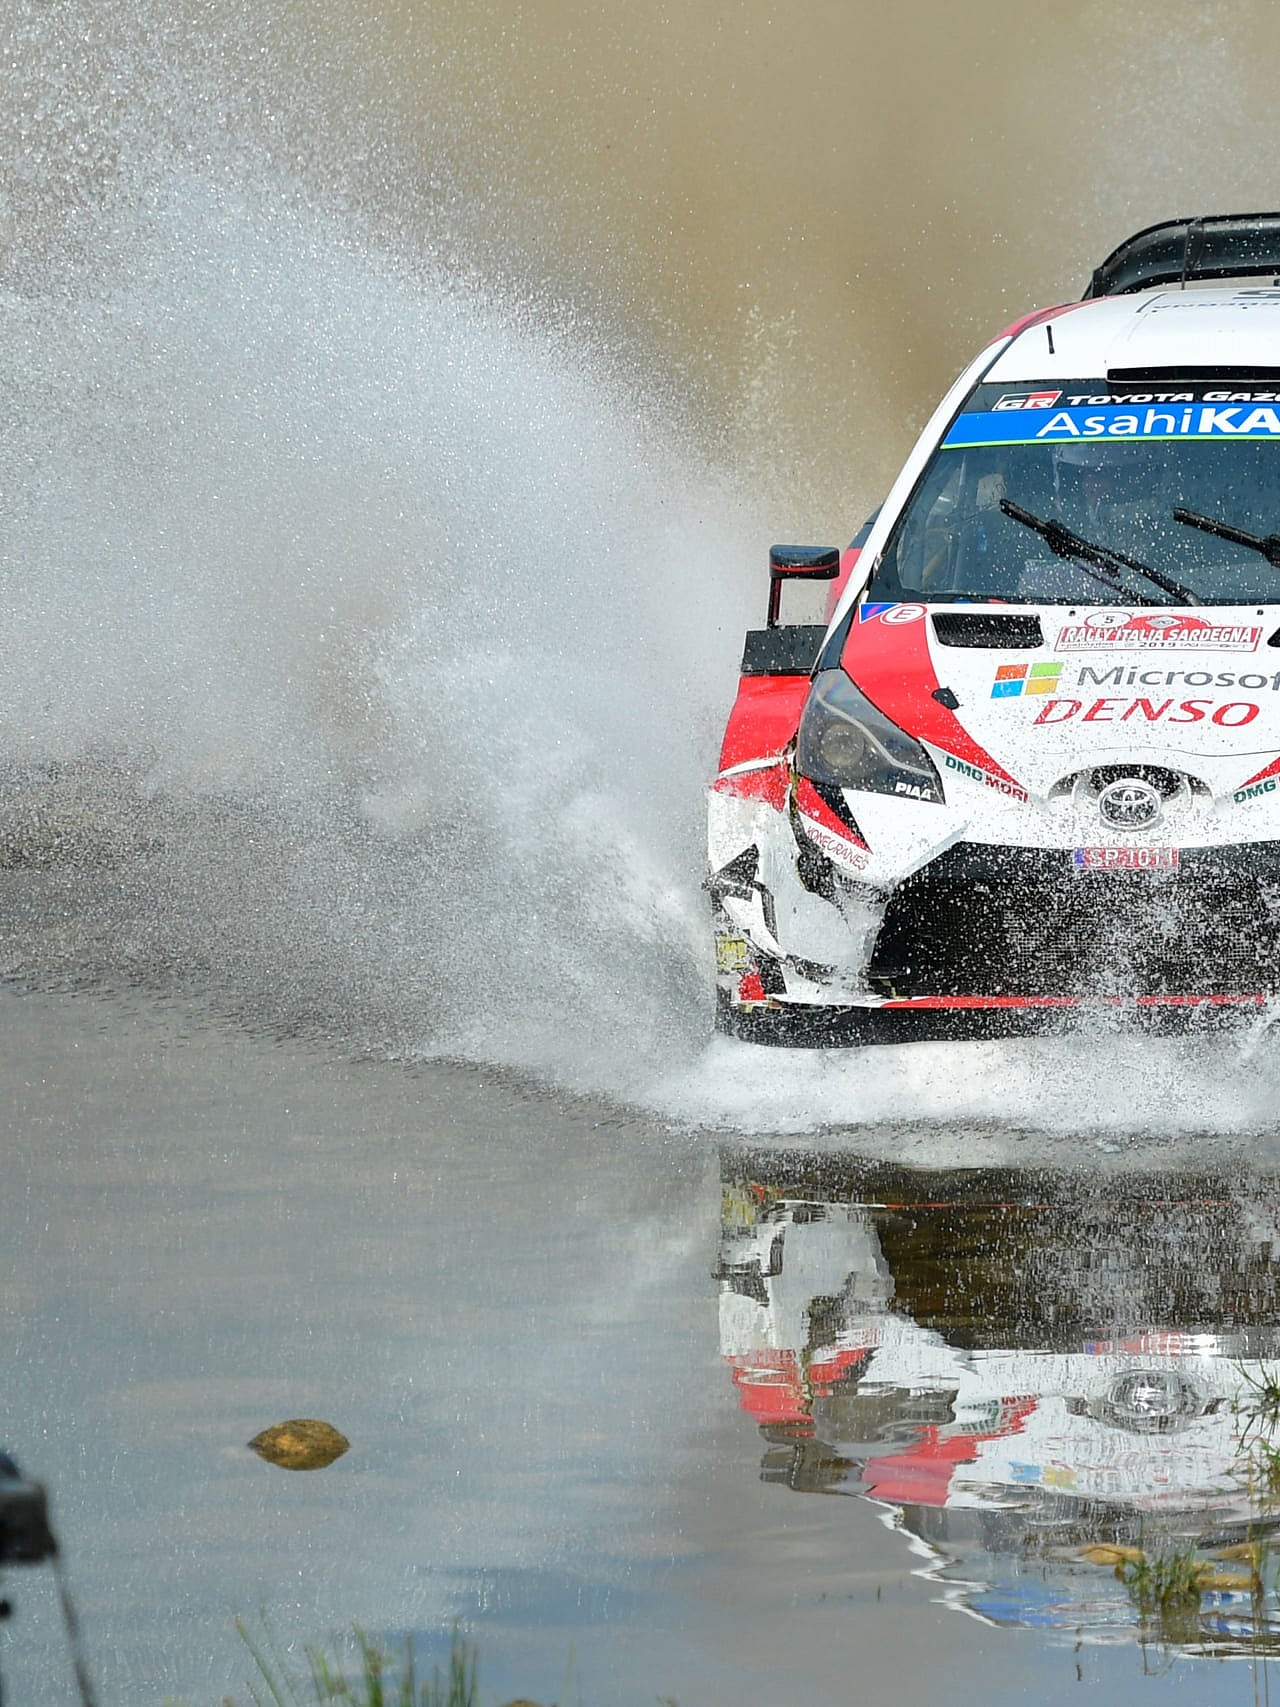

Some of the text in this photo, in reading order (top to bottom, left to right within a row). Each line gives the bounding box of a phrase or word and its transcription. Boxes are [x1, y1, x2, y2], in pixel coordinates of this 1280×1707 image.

[1066, 392, 1194, 406] TOYOTA
[892, 608, 918, 620] E
[1103, 615, 1117, 625] 5
[1064, 626, 1256, 643] RALLY ITALIA SARDEGNA
[1138, 641, 1177, 649] 2019
[1033, 697, 1261, 727] DENSO
[945, 755, 1030, 804] DMG MORI
[894, 781, 933, 801] PIAA
[1233, 779, 1277, 805] DMG
[806, 825, 870, 872] KONECRANES
